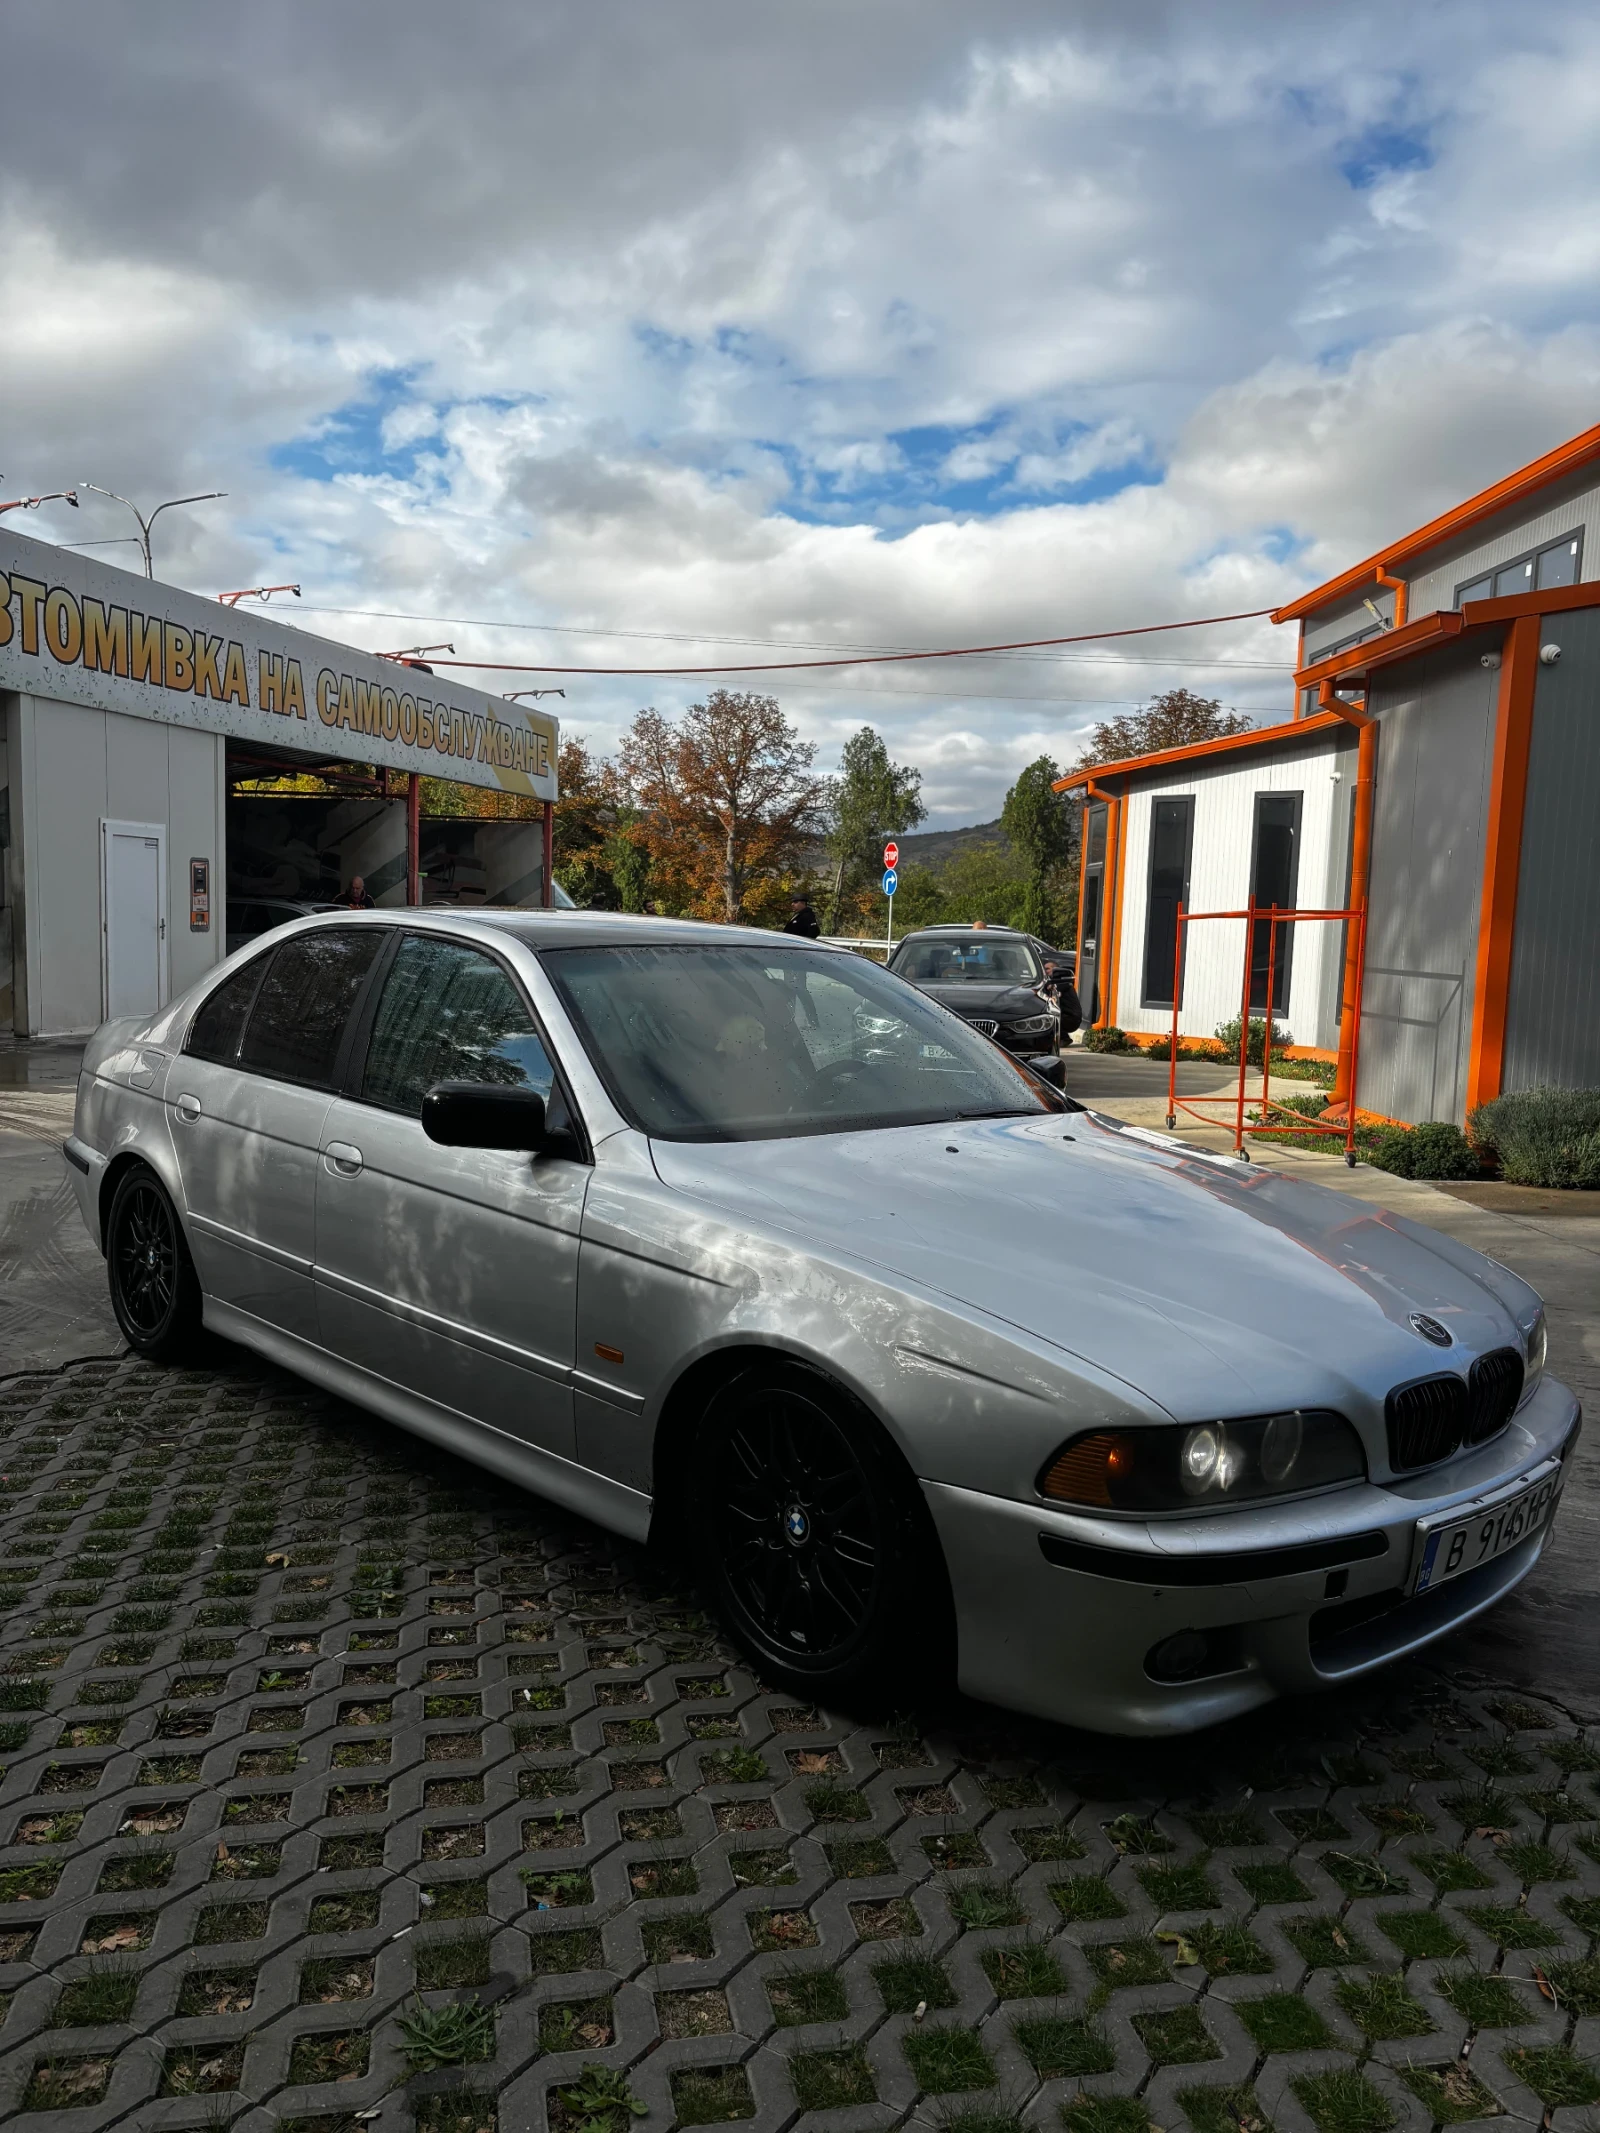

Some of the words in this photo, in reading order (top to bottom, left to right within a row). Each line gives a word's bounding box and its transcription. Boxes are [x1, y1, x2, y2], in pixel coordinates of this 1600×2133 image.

[258, 649, 307, 721] НА
[316, 667, 549, 778] САМООБСЛУЖВАНЕ
[1444, 1529, 1467, 1575] B
